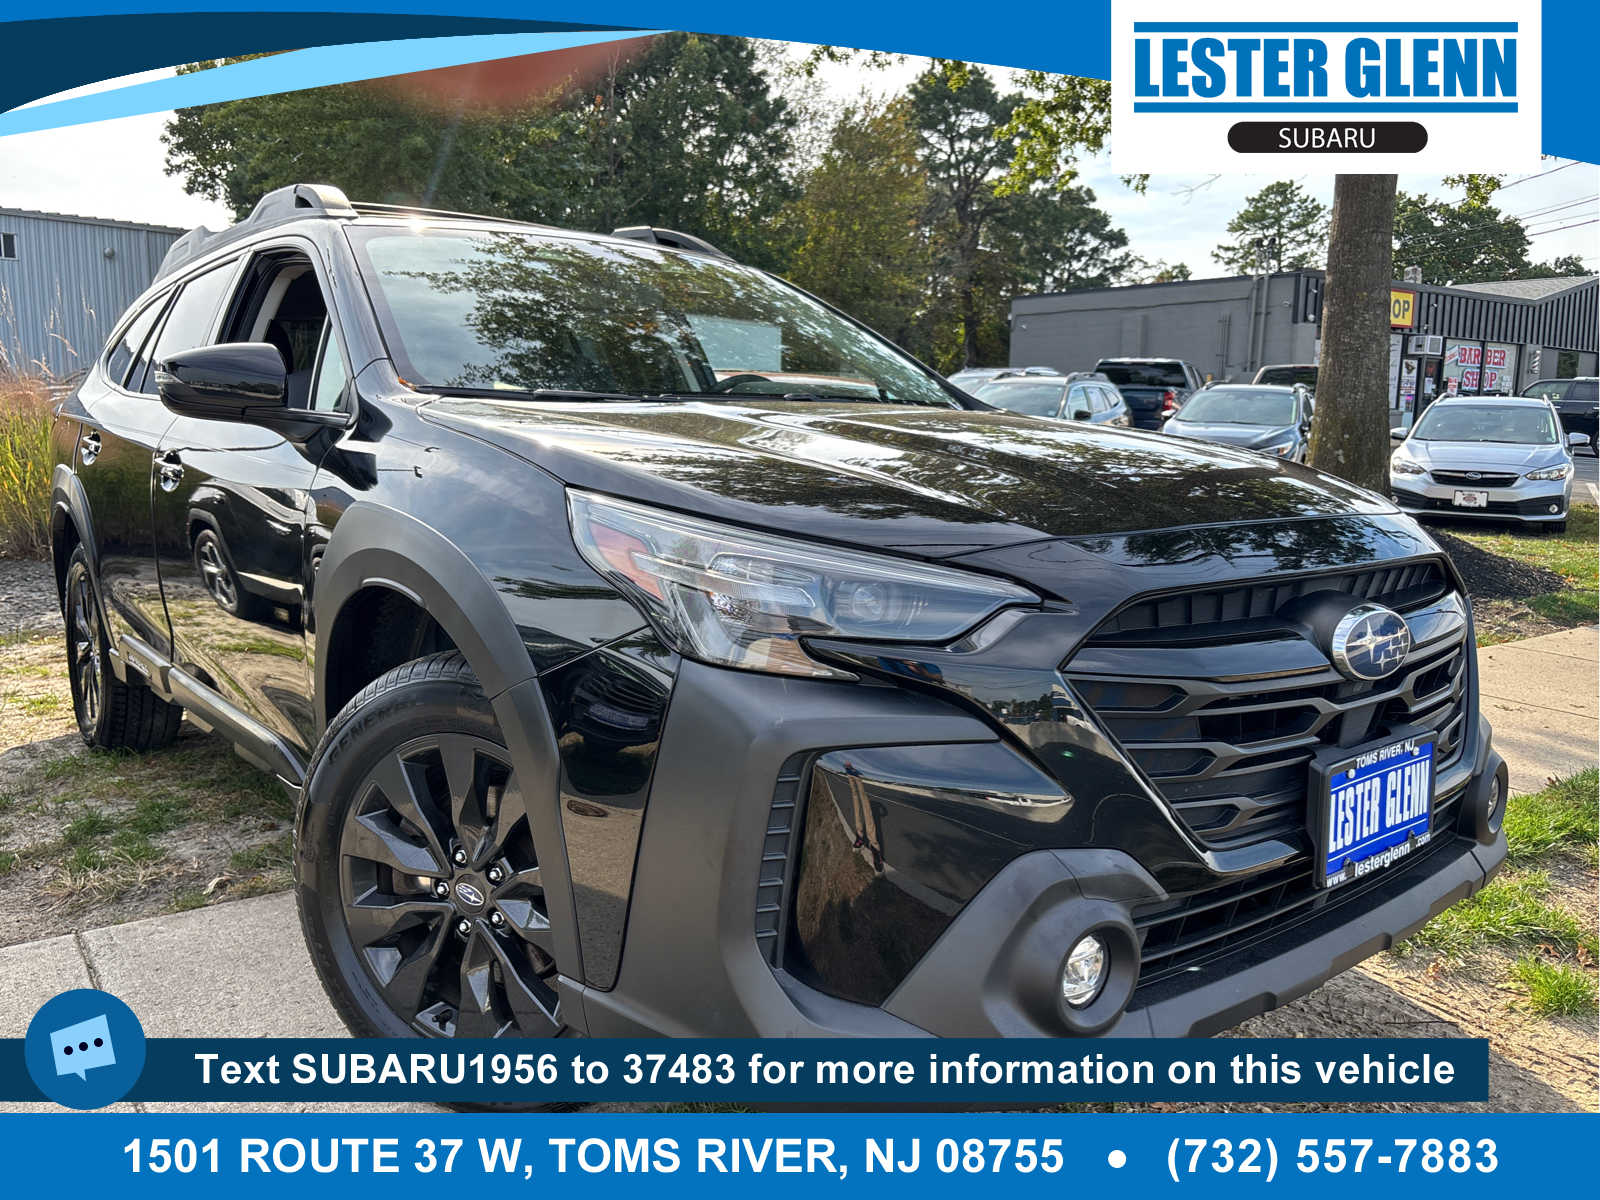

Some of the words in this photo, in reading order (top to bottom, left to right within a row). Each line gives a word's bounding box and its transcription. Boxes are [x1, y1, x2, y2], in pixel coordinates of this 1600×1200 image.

[1392, 299, 1410, 319] OP
[1459, 347, 1506, 367] BARBER
[1463, 370, 1497, 389] SHOP
[1356, 751, 1378, 769] TOMS
[1405, 739, 1415, 752] NJ
[1328, 778, 1381, 853] LESTER
[1385, 759, 1430, 828] GLENN
[1354, 842, 1410, 877] lesterglenn
